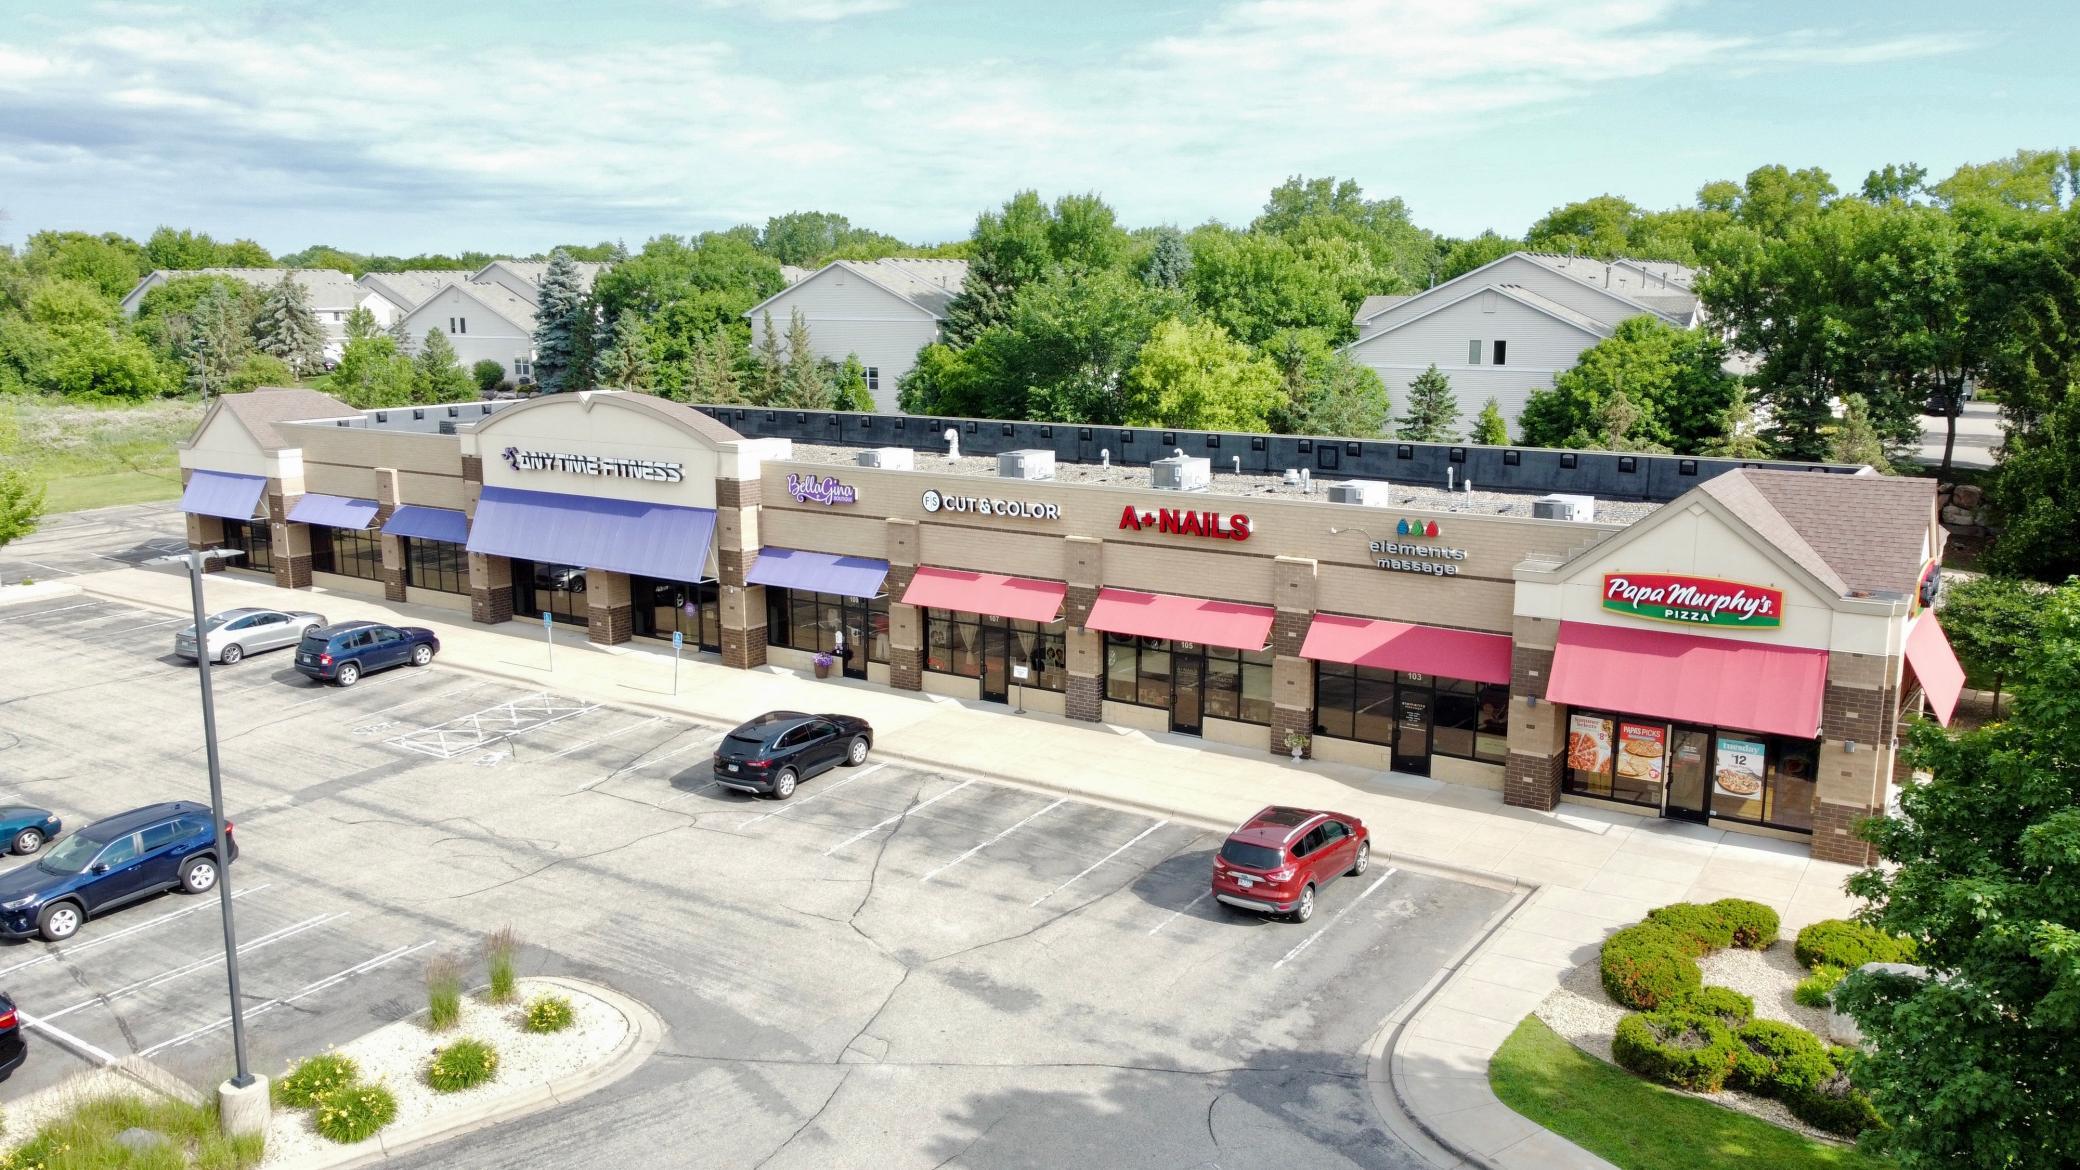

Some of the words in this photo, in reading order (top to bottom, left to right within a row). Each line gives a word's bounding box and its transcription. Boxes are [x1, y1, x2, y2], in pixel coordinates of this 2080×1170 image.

[518, 451, 600, 475] ANYTIME
[602, 457, 682, 483] FITNESS
[943, 496, 977, 513] CUT
[979, 498, 993, 514] &
[995, 500, 1059, 520] COLOR
[1370, 540, 1466, 560] elements
[1377, 557, 1457, 576] massage
[1608, 578, 1666, 609] Papa
[1666, 583, 1773, 621] Murphy's
[1664, 609, 1710, 622] PIZZA
[1408, 672, 1422, 681] 103
